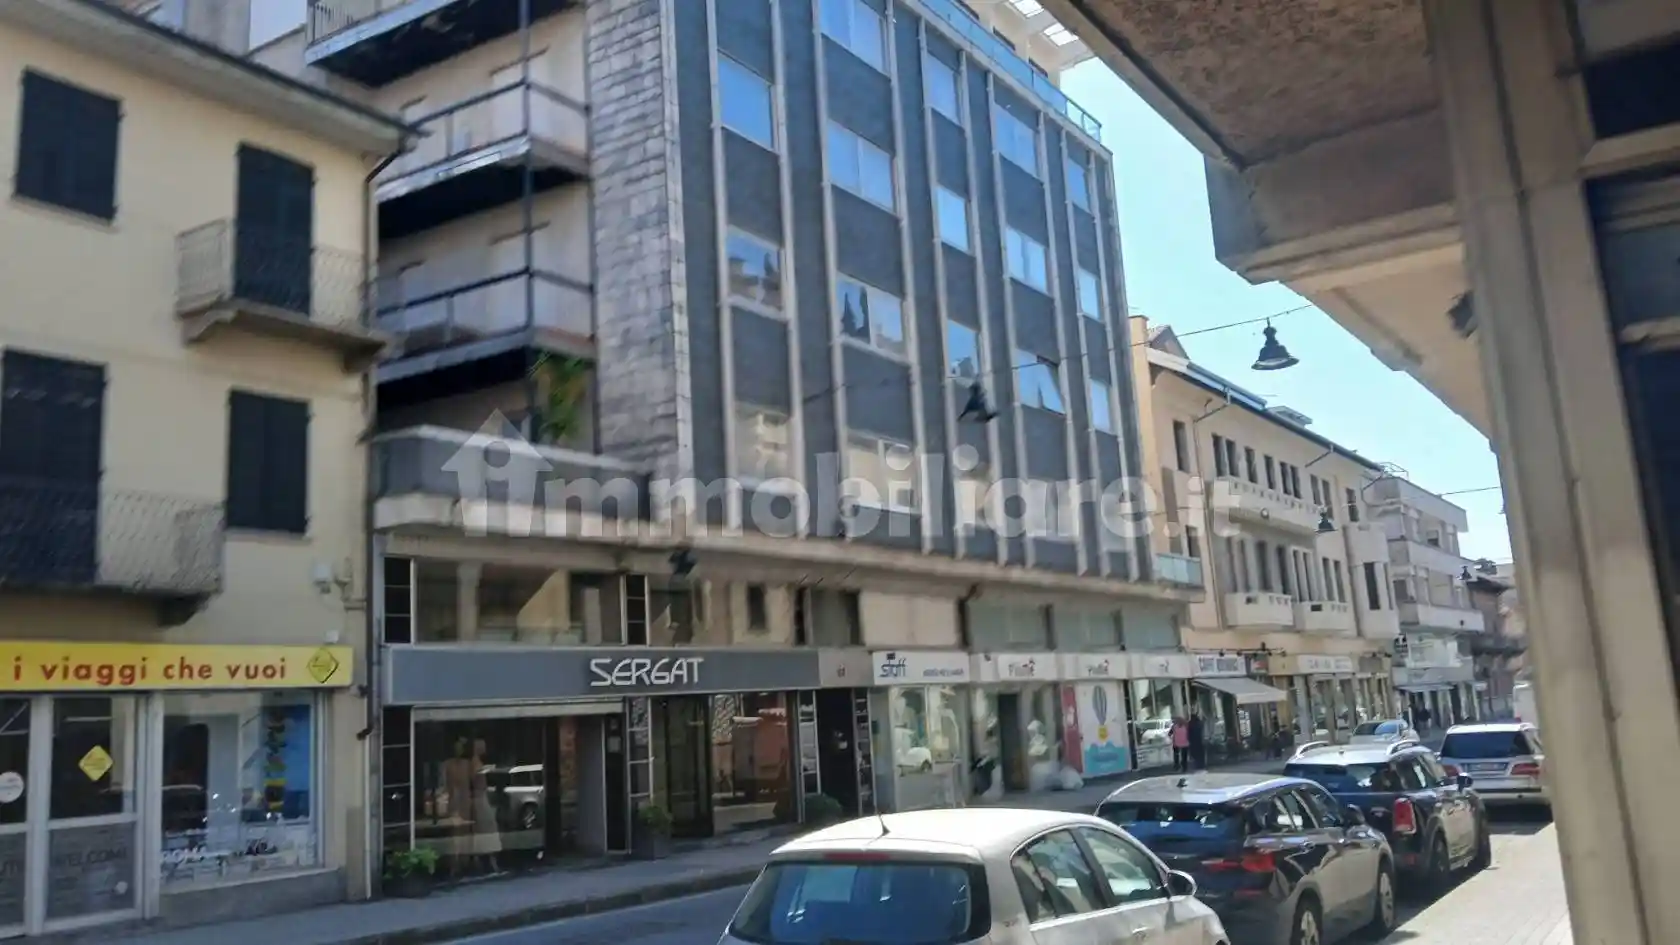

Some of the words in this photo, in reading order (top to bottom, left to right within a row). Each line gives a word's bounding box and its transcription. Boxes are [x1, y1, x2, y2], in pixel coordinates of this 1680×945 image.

[13, 656, 22, 681] i
[40, 656, 148, 685] viaggi
[163, 656, 212, 681] che
[226, 657, 286, 680] vuoi
[590, 658, 704, 686] SERGAT
